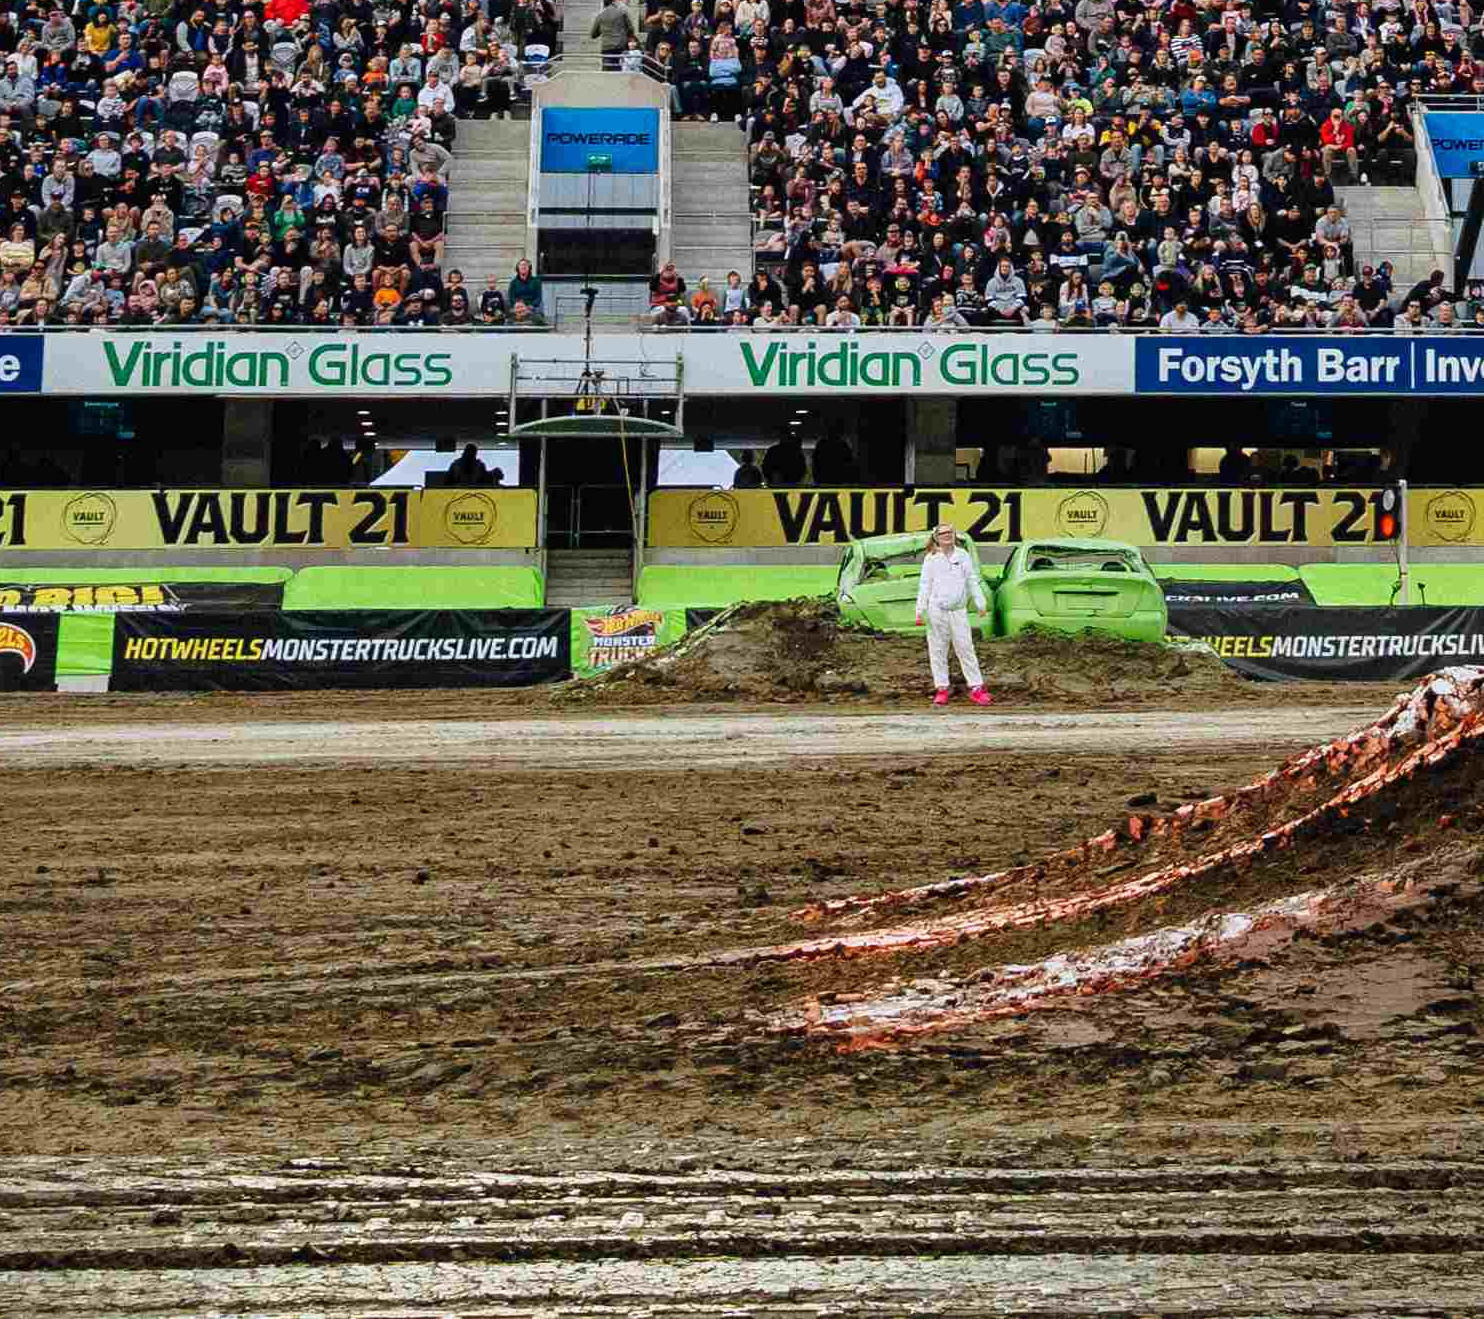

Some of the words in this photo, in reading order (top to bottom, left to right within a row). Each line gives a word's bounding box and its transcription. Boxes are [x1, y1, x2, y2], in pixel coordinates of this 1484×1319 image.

[103, 340, 291, 387] Viridian
[307, 342, 452, 387] Glass
[739, 341, 920, 387] Viridian
[939, 343, 1080, 387] Glass
[1157, 346, 1303, 393] Forsyth
[1316, 347, 1401, 385] Barr
[72, 509, 106, 522] VAULT
[153, 490, 343, 546] VAULT
[348, 491, 409, 544] 21
[452, 509, 486, 522] VAULT
[695, 509, 729, 521] VAULT
[771, 490, 964, 543] VAULT
[962, 490, 1023, 543] 21
[1066, 508, 1099, 520] VAULT
[1140, 490, 1327, 544] VAULT
[1433, 508, 1466, 520] VAULT
[124, 636, 558, 662] HOTWHEELSMONSTERTRUCKSLIVE.COM
